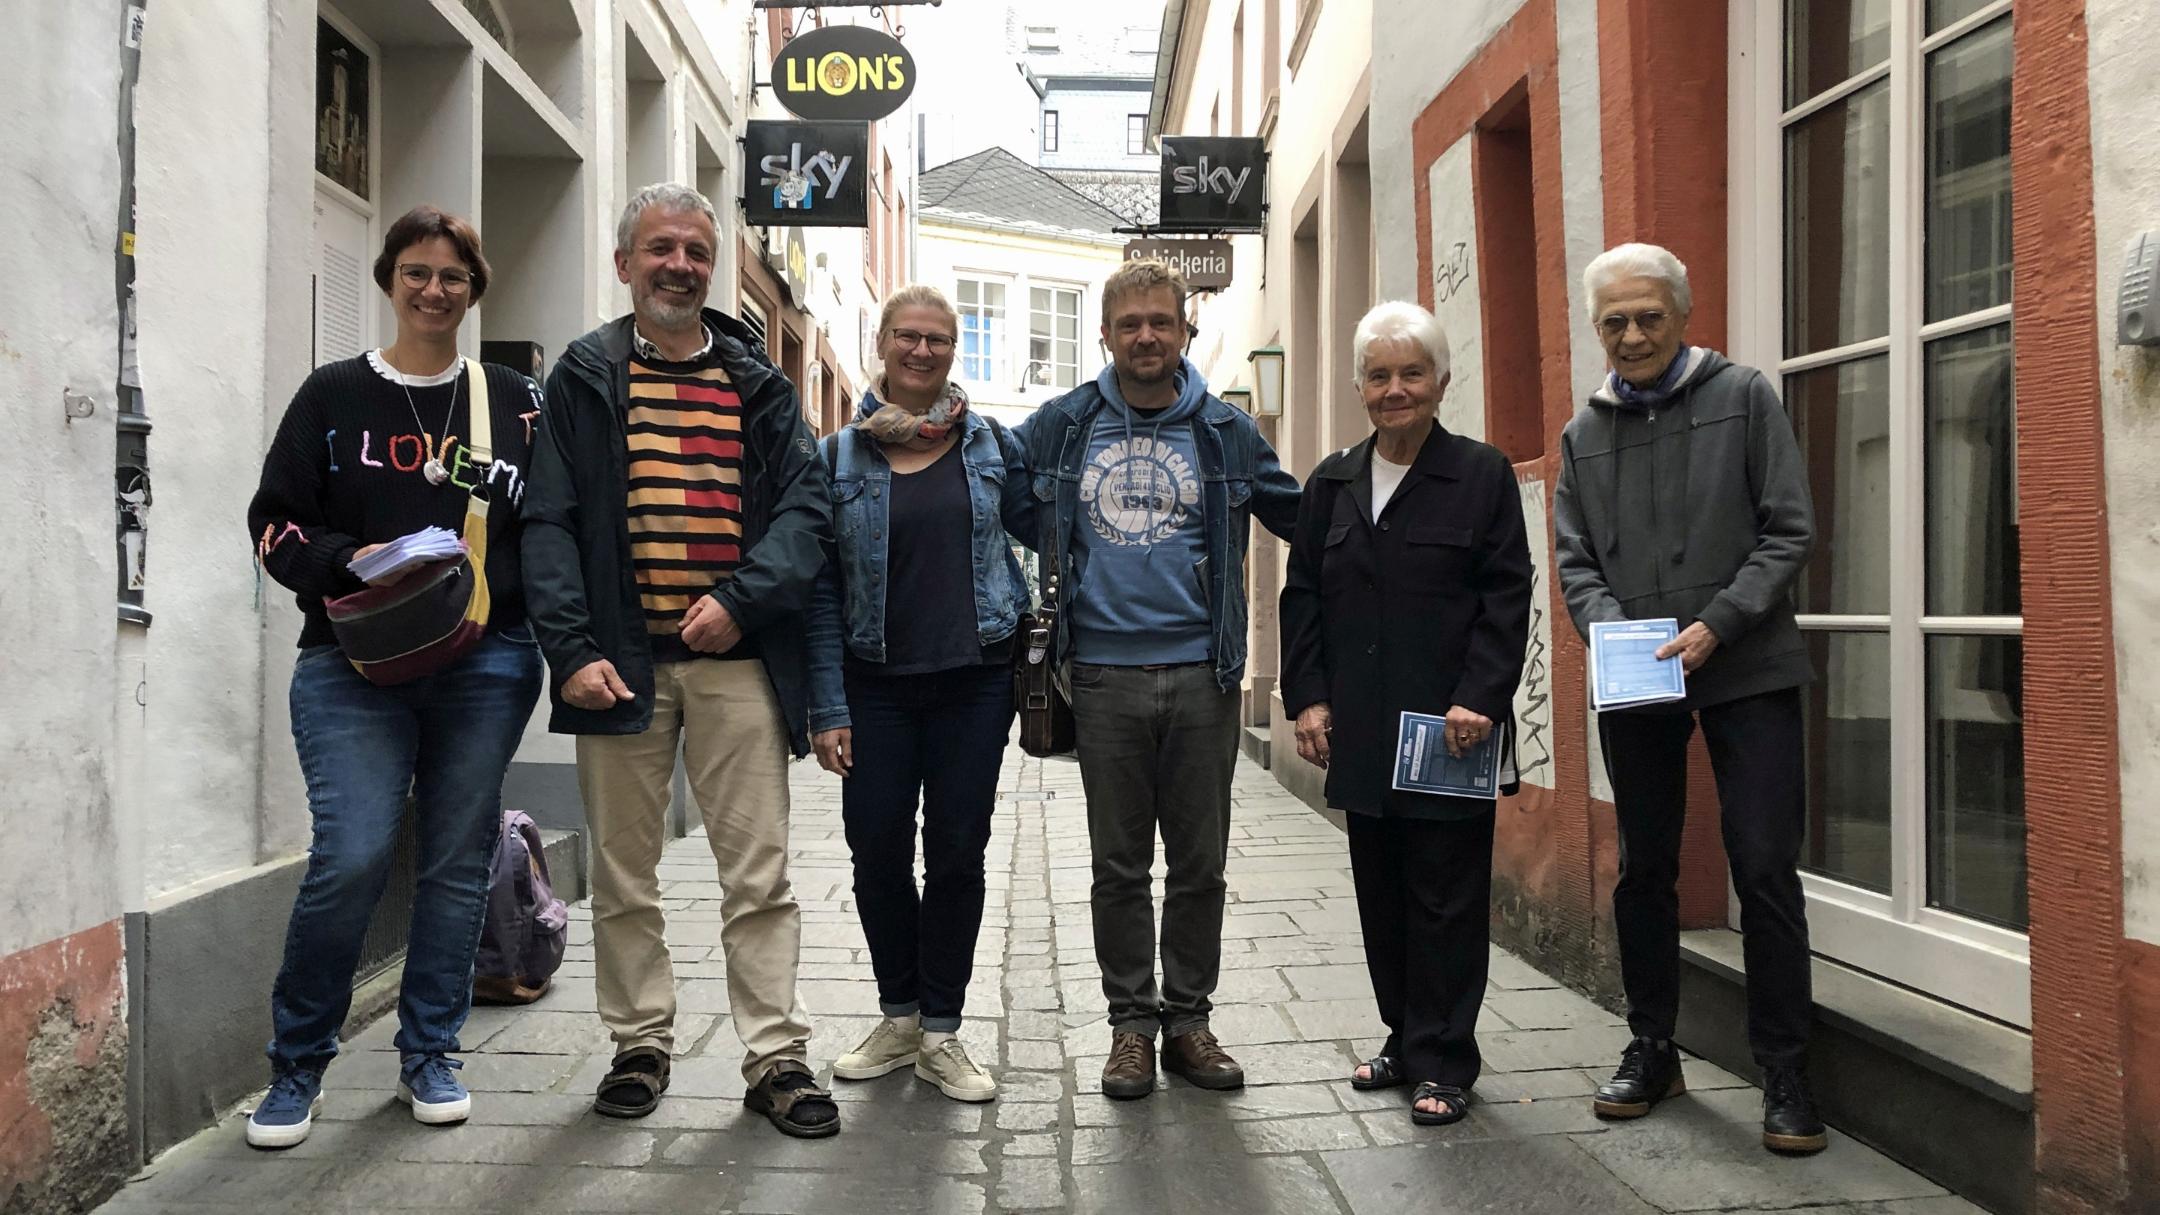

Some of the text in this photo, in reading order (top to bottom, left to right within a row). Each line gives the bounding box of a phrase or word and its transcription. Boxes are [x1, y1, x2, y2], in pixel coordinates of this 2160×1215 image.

[786, 51, 905, 96] LION'S
[760, 142, 852, 199] sky
[1172, 155, 1251, 204] sky
[1130, 248, 1226, 280] ickeria
[326, 429, 339, 472] I
[360, 430, 471, 490] LOVE
